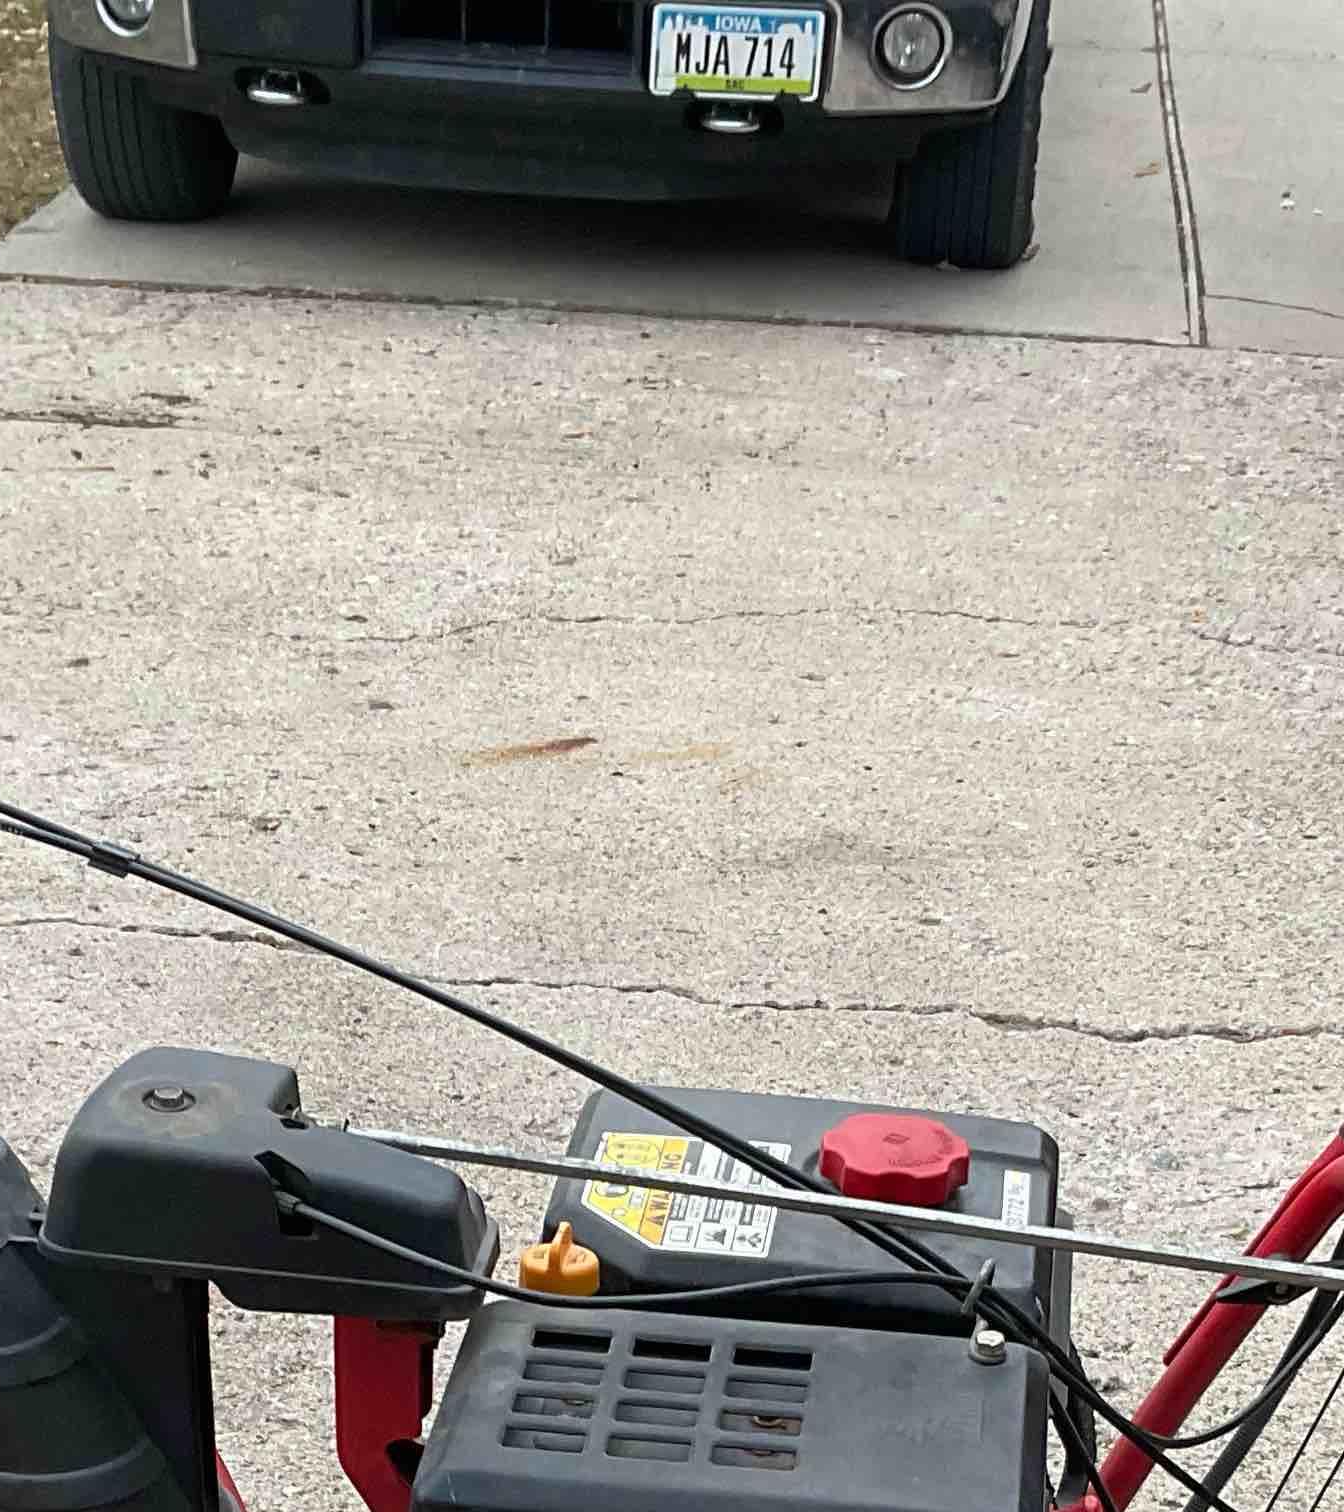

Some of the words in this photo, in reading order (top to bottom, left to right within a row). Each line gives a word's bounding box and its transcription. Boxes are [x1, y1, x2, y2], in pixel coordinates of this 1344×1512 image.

[715, 14, 762, 33] IOWA
[675, 33, 730, 75] MJA
[744, 36, 795, 78] 714
